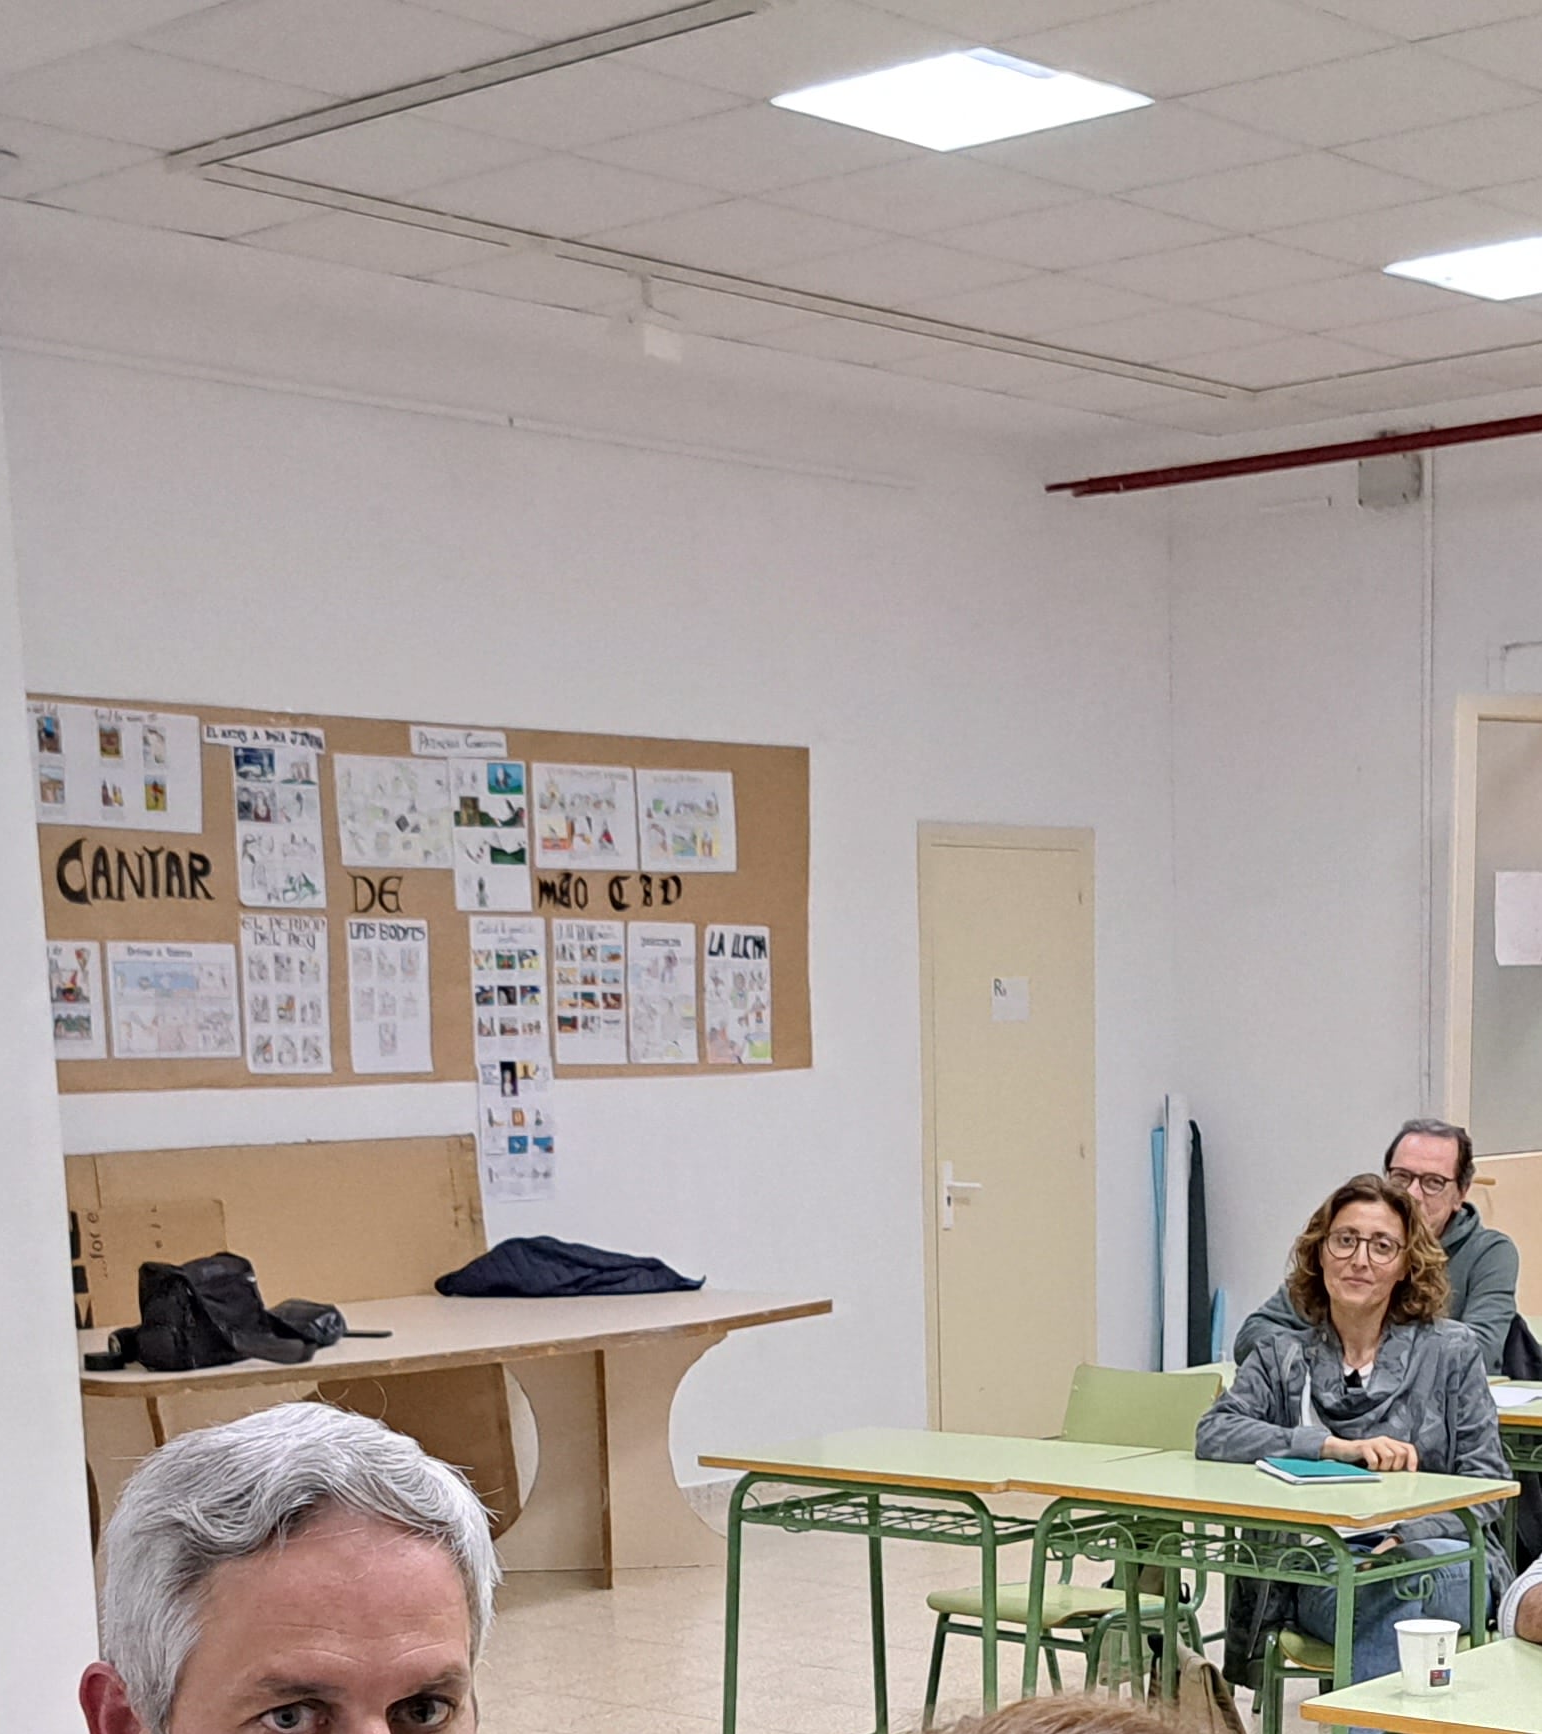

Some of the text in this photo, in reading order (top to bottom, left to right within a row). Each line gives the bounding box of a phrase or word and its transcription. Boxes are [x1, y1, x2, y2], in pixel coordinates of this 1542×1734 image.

[56, 838, 215, 905] CANTAR
[348, 871, 403, 913] DE
[708, 931, 725, 957] LA
